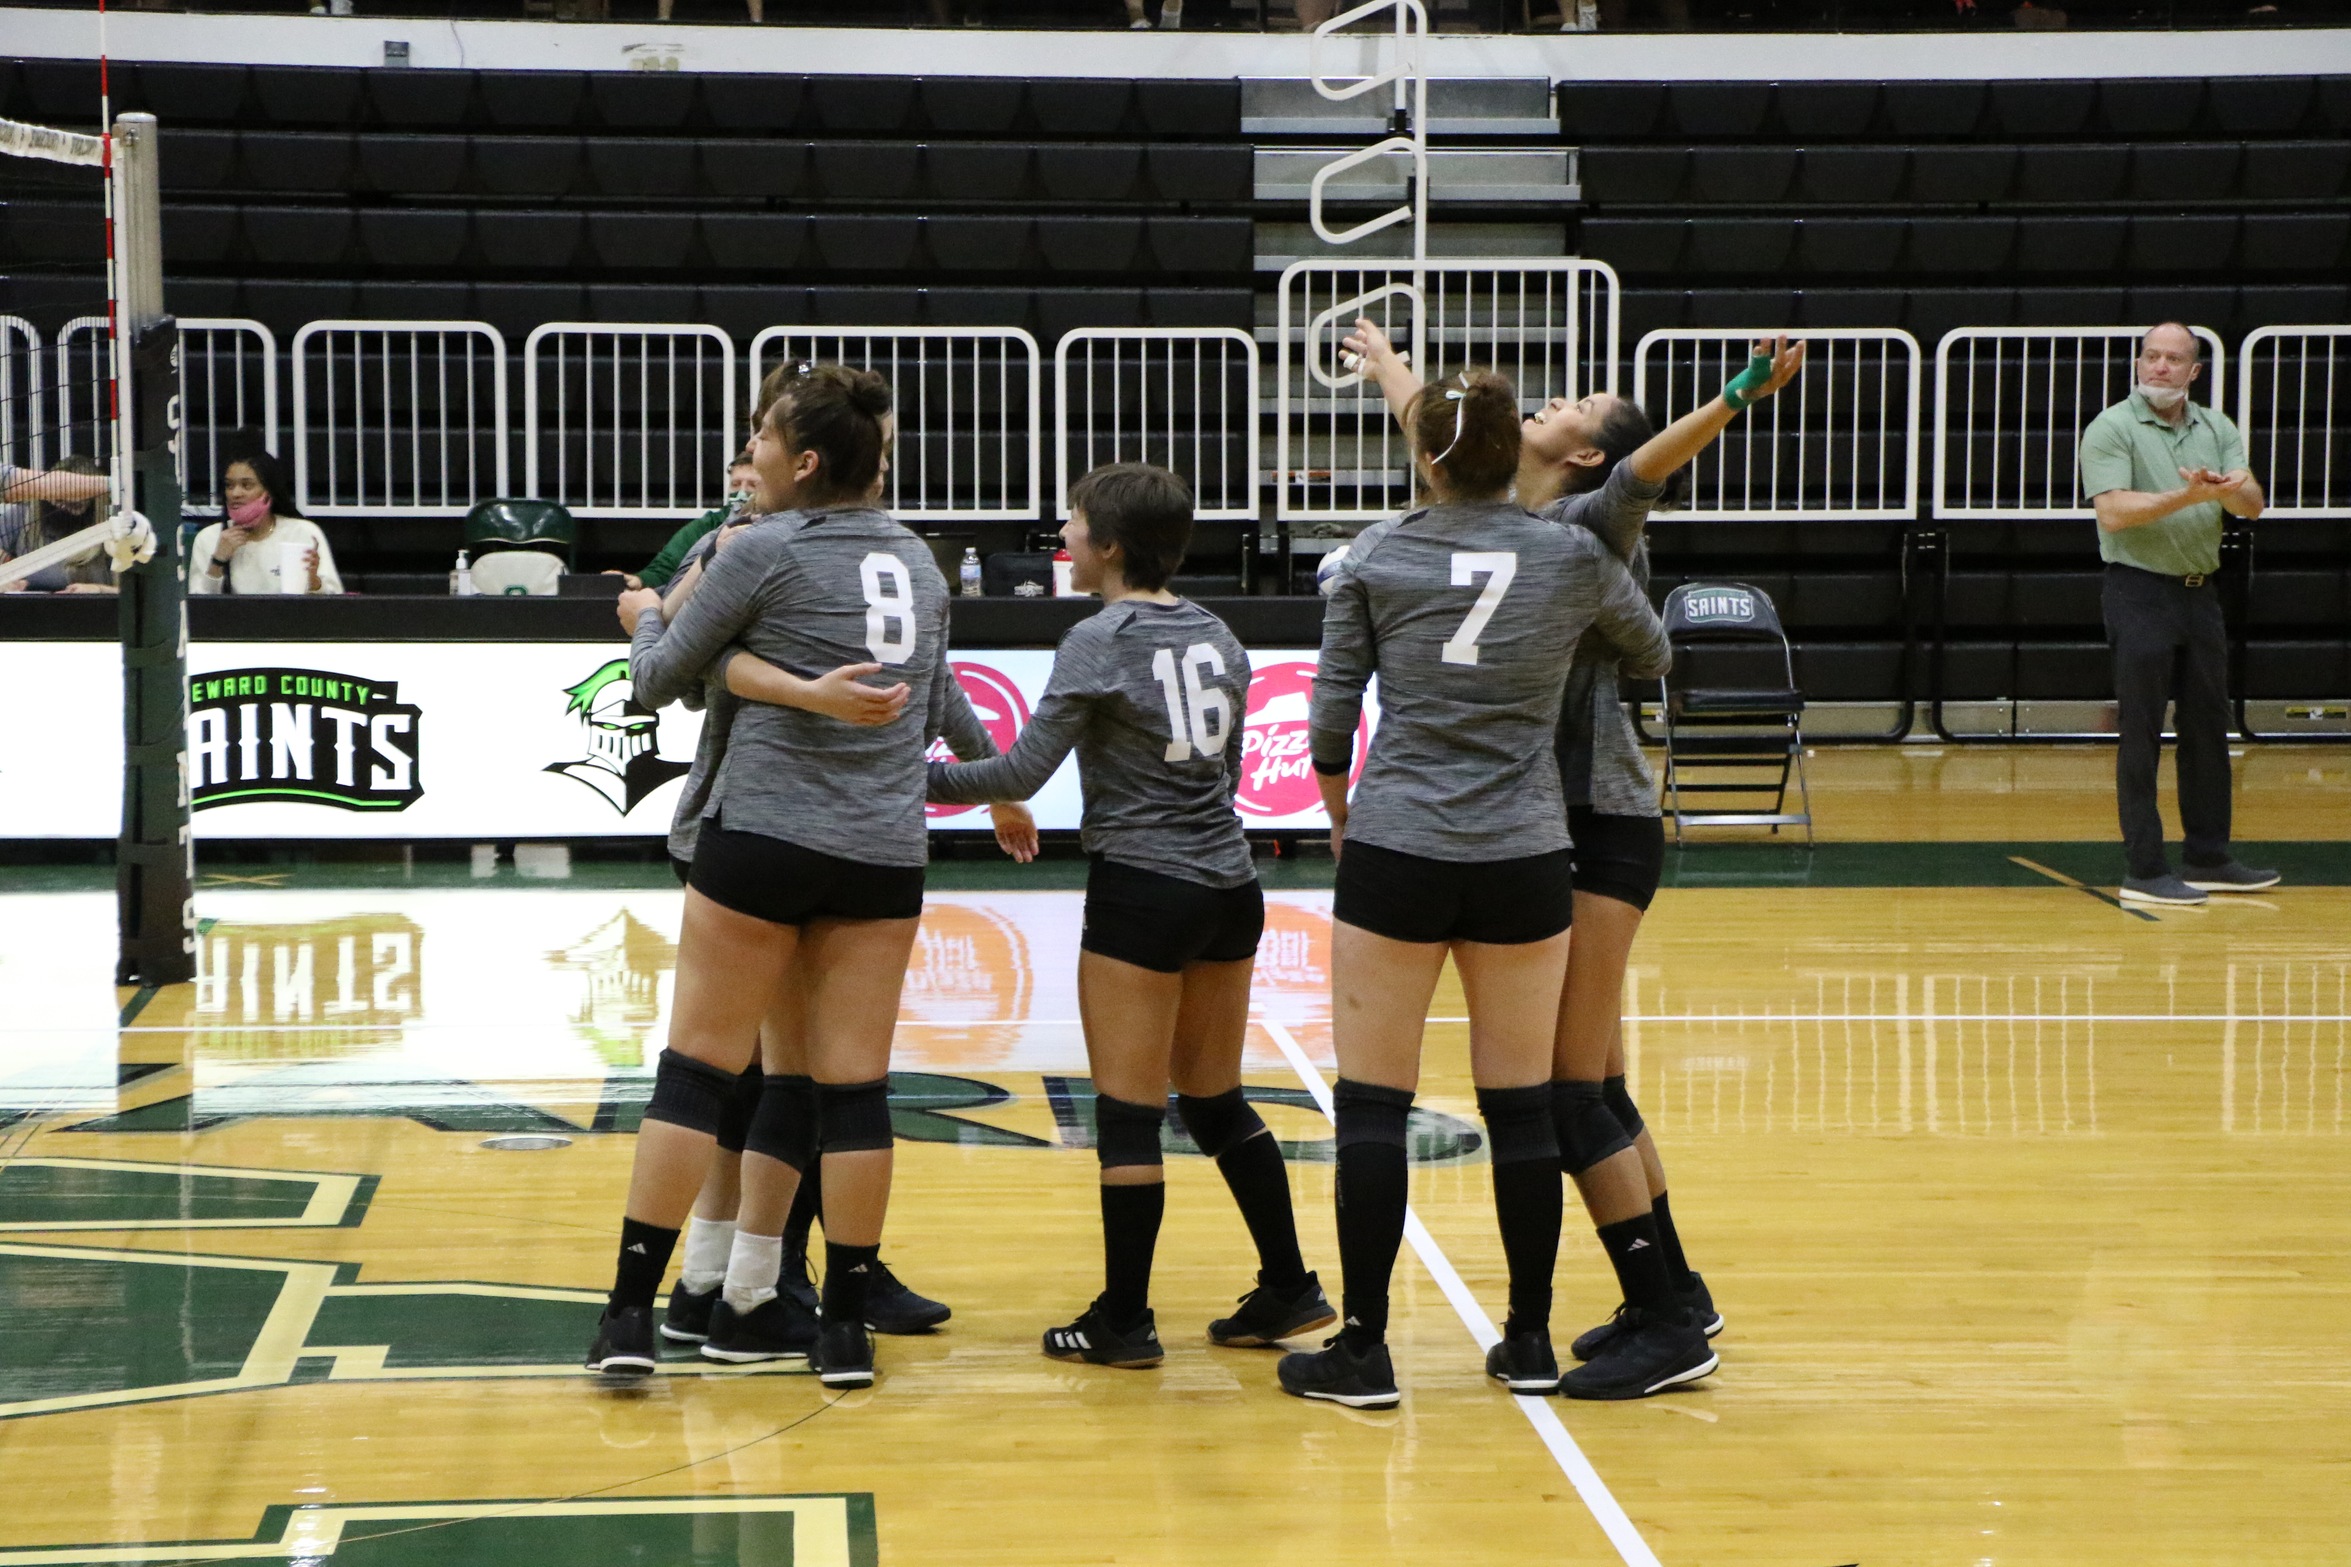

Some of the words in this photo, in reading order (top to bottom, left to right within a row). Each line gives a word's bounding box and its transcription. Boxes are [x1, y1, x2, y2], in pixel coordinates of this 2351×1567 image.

[860, 552, 916, 664] 8
[1441, 552, 1516, 666] 7
[1687, 596, 1751, 617] SAINTS
[191, 675, 268, 702] EWARD
[280, 675, 369, 705] COUNTY
[1152, 643, 1230, 762] 16
[187, 703, 413, 790] AINTS
[1241, 724, 1310, 760] Pizz
